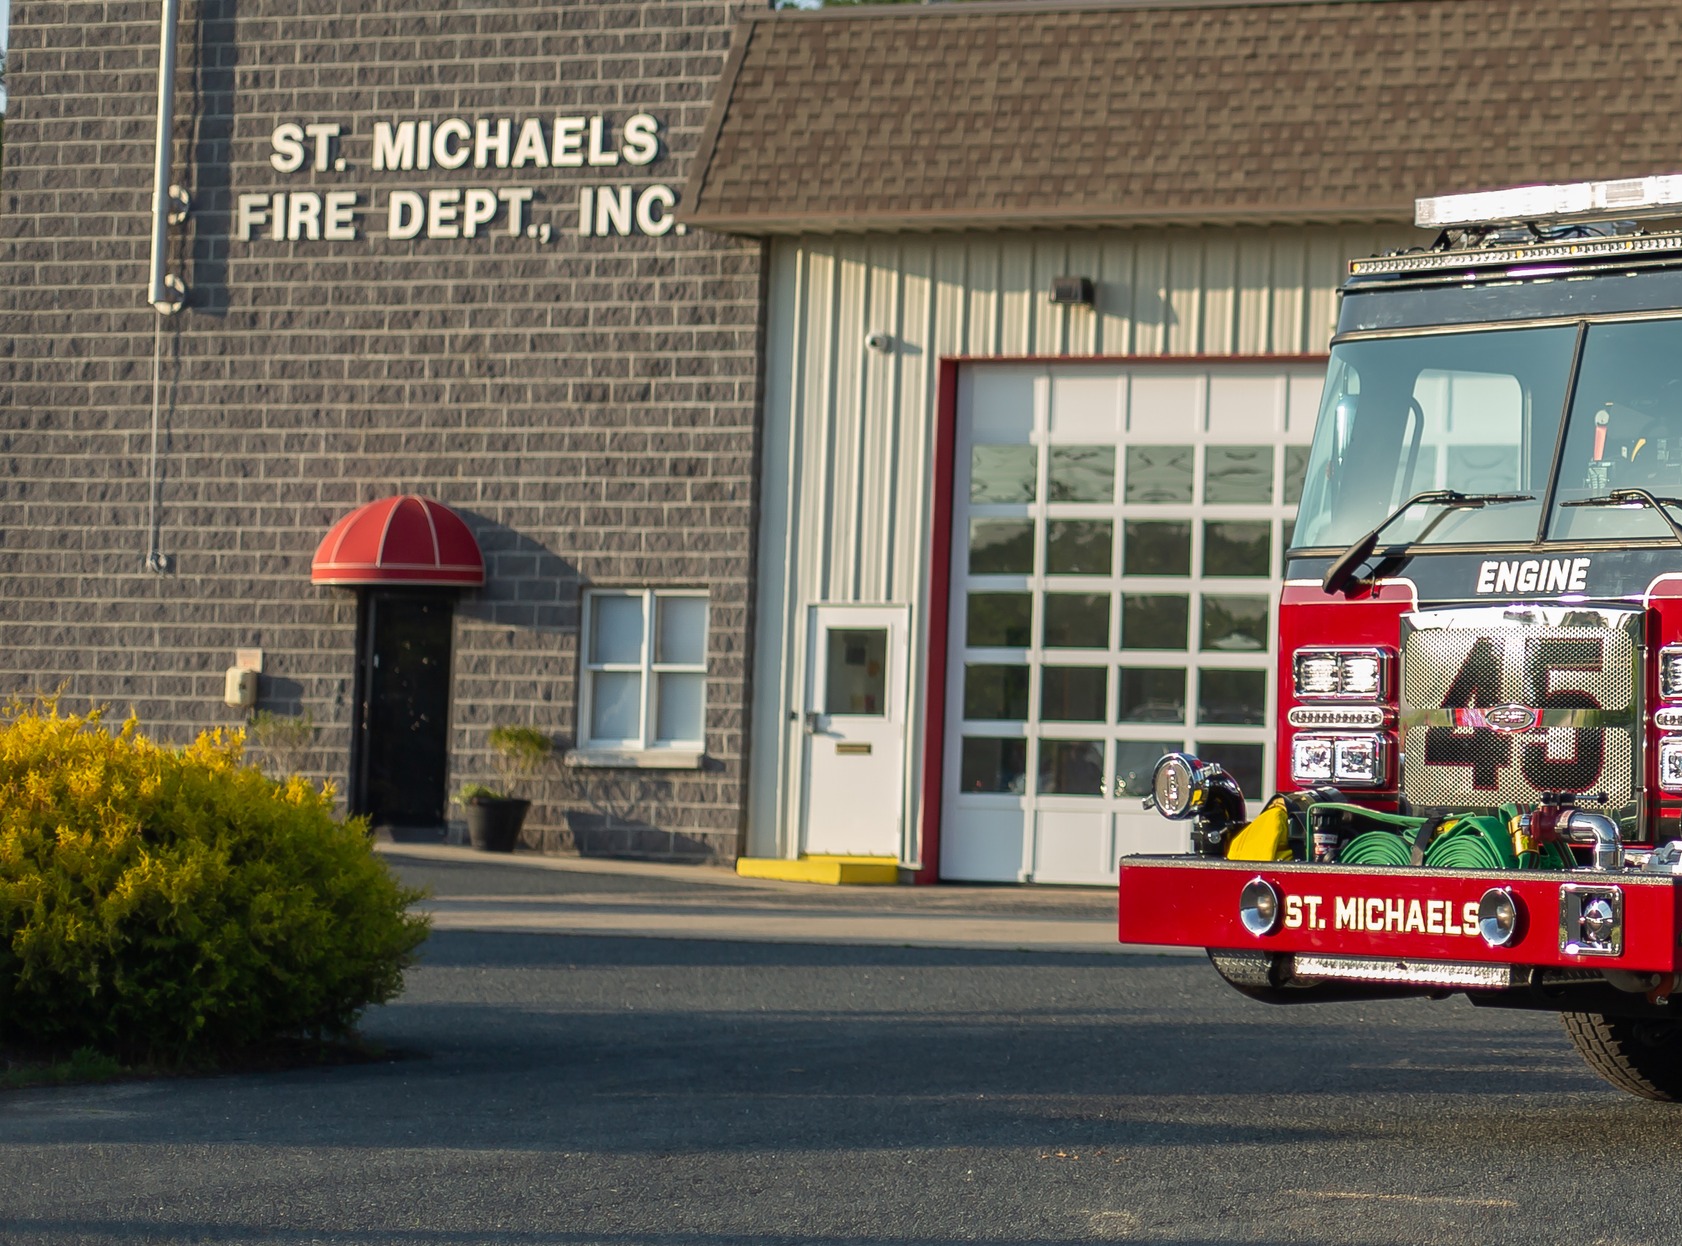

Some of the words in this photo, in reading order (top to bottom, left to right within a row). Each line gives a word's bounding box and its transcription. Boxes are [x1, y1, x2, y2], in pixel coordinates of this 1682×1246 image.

[269, 122, 346, 173] ST.
[372, 113, 659, 171] MICHAELS
[237, 191, 357, 242] FIRE
[387, 186, 551, 244] DEPT.,
[577, 183, 687, 237] INC.
[1476, 557, 1592, 594] ENGINE
[1424, 635, 1606, 794] 45
[1284, 895, 1327, 930] ST.
[1333, 895, 1481, 937] MICHAELS
